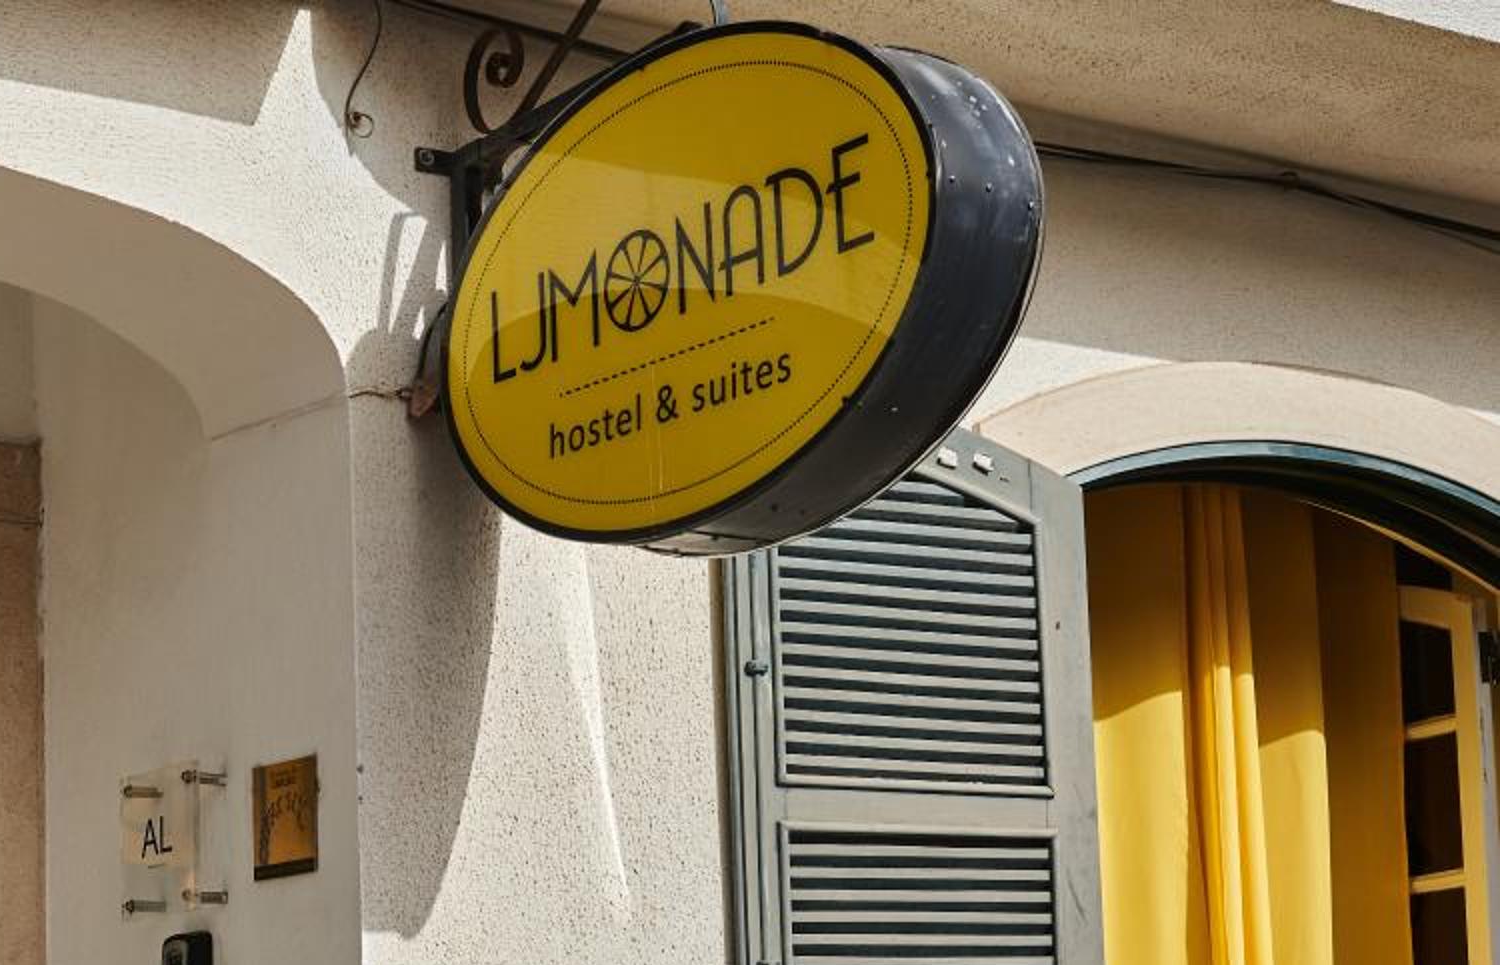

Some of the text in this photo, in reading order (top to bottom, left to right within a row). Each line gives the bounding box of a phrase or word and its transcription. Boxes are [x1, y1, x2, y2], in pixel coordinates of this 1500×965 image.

[549, 352, 792, 459] hostel & suites
[141, 815, 173, 860] AL
